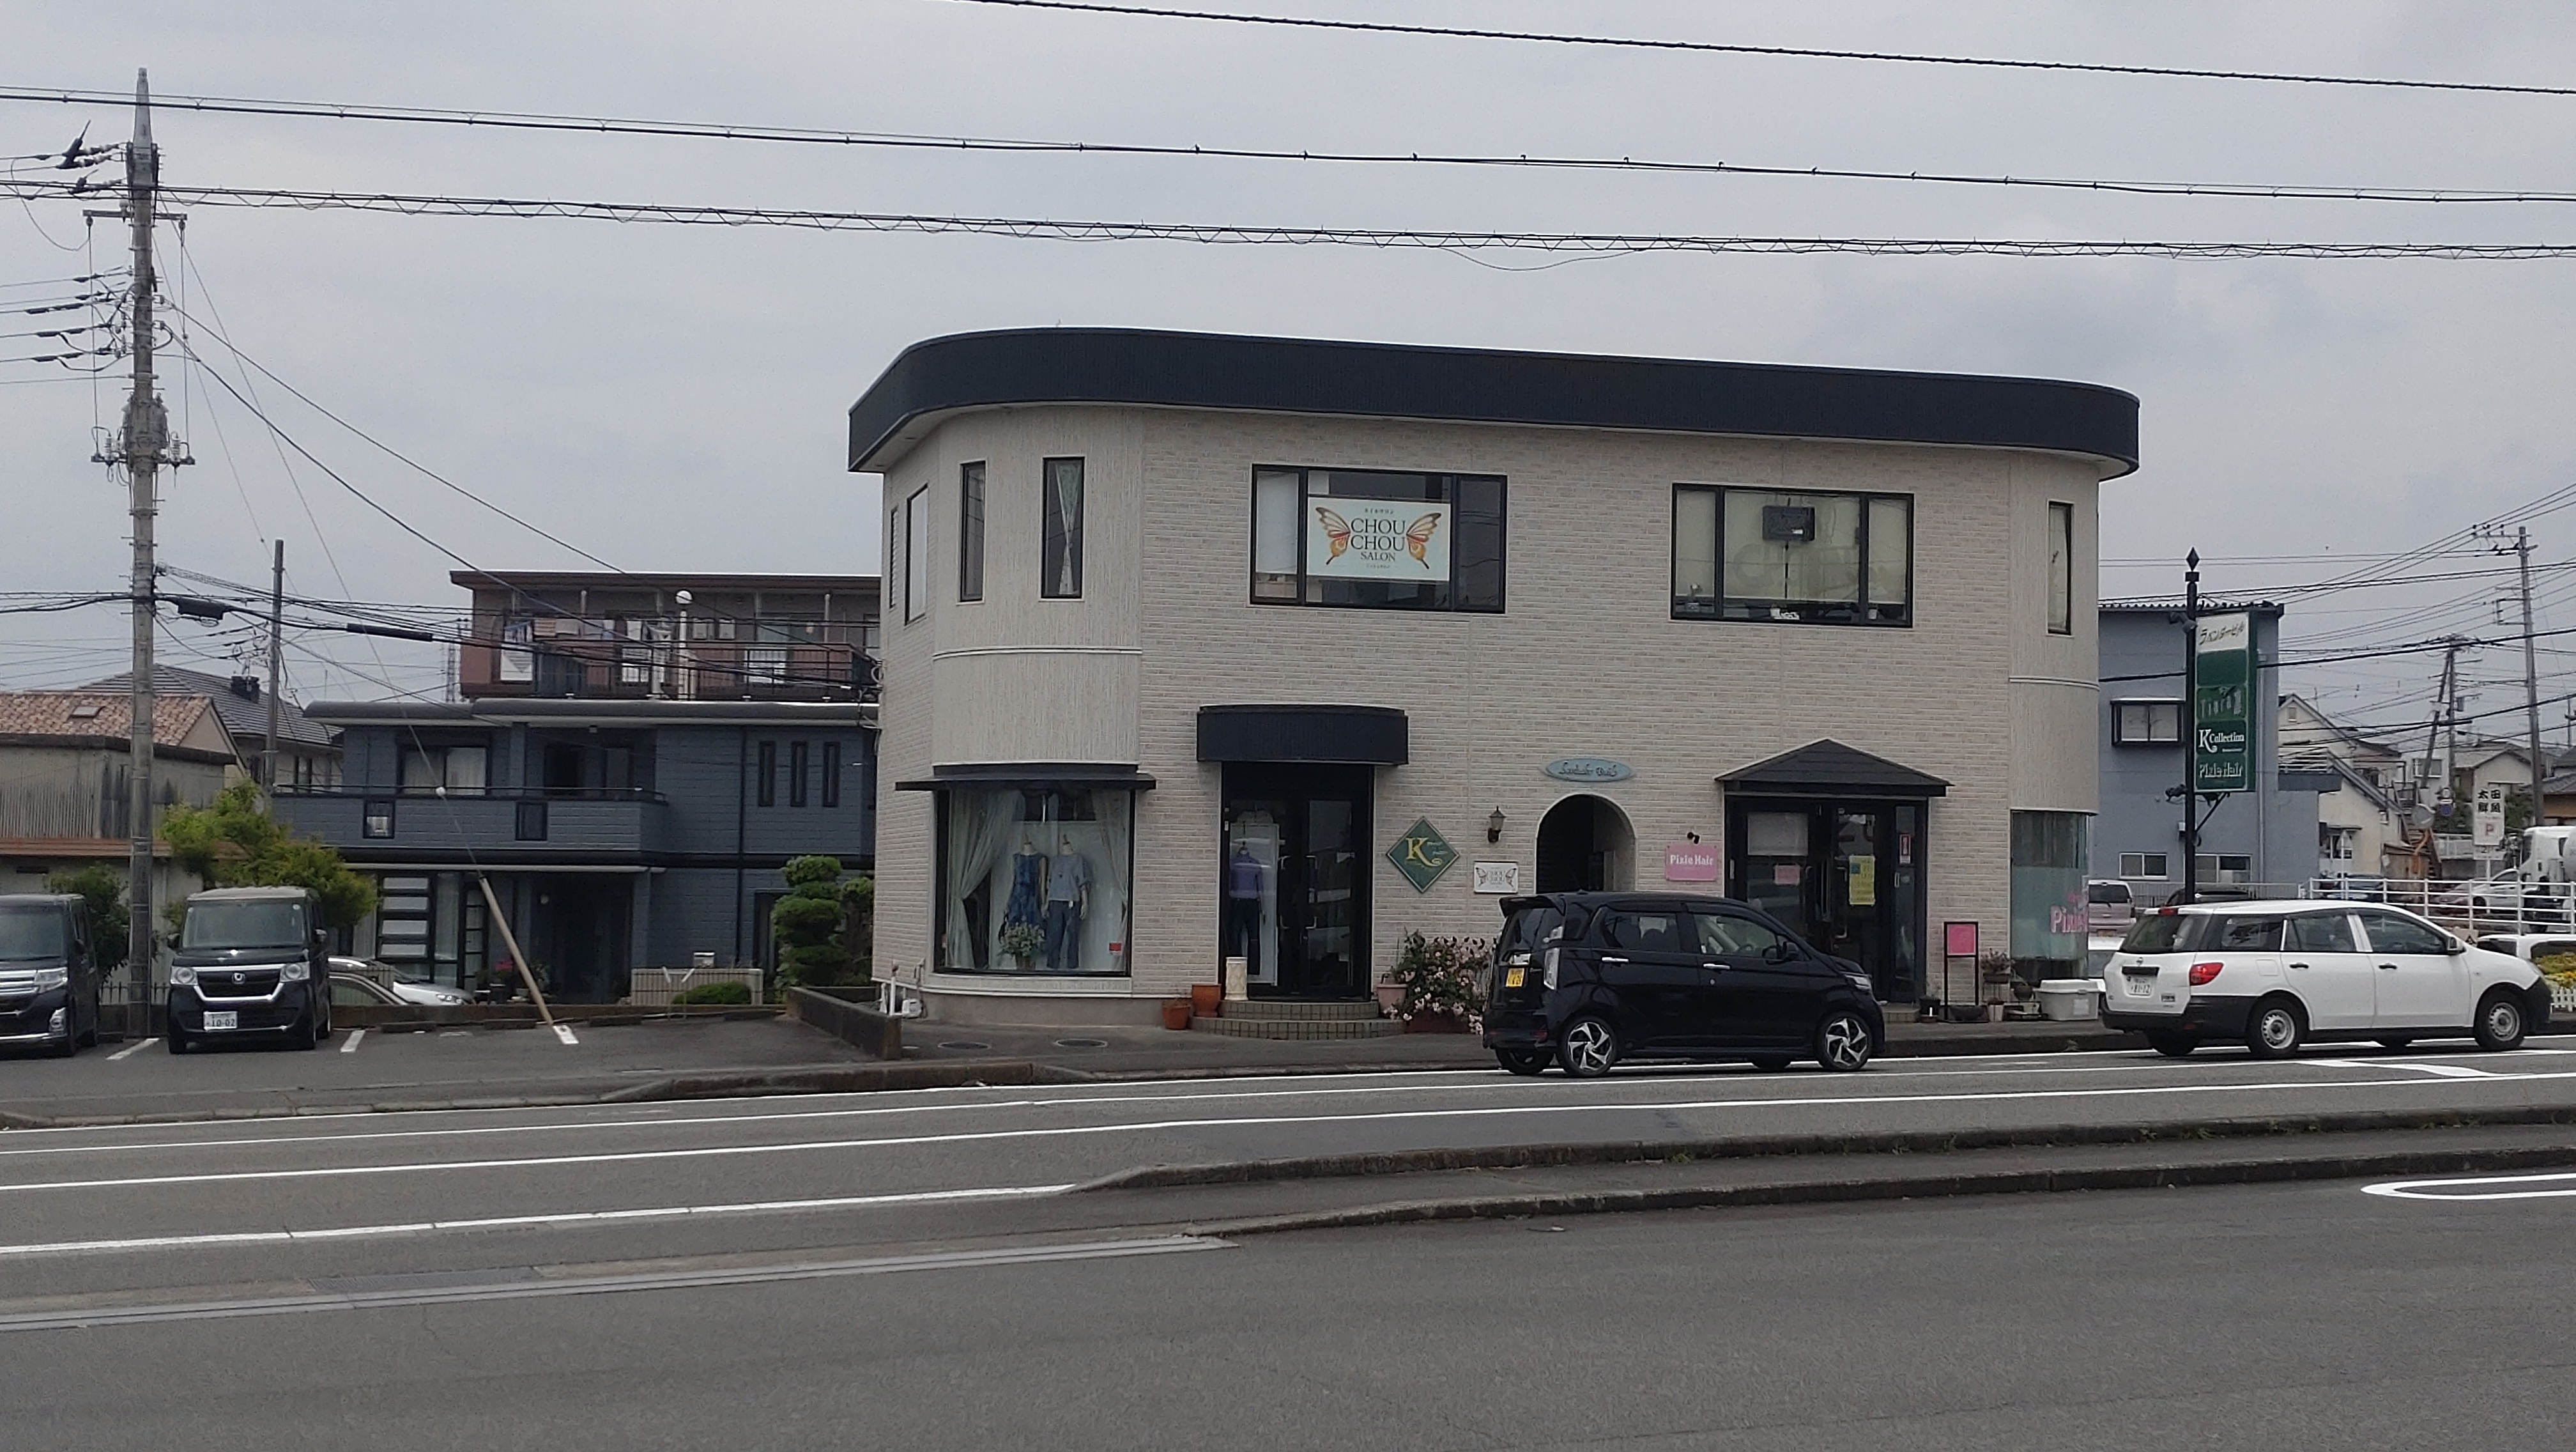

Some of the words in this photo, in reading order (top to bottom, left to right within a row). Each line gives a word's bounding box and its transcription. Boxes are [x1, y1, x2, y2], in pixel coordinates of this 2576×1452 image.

[1351, 518, 1406, 535] CHOU
[1351, 534, 1406, 552] CHOU
[1360, 551, 1396, 562] SALON
[1406, 837, 1443, 867] K
[1670, 854, 1694, 865] Pixie
[1694, 854, 1713, 865] Hair
